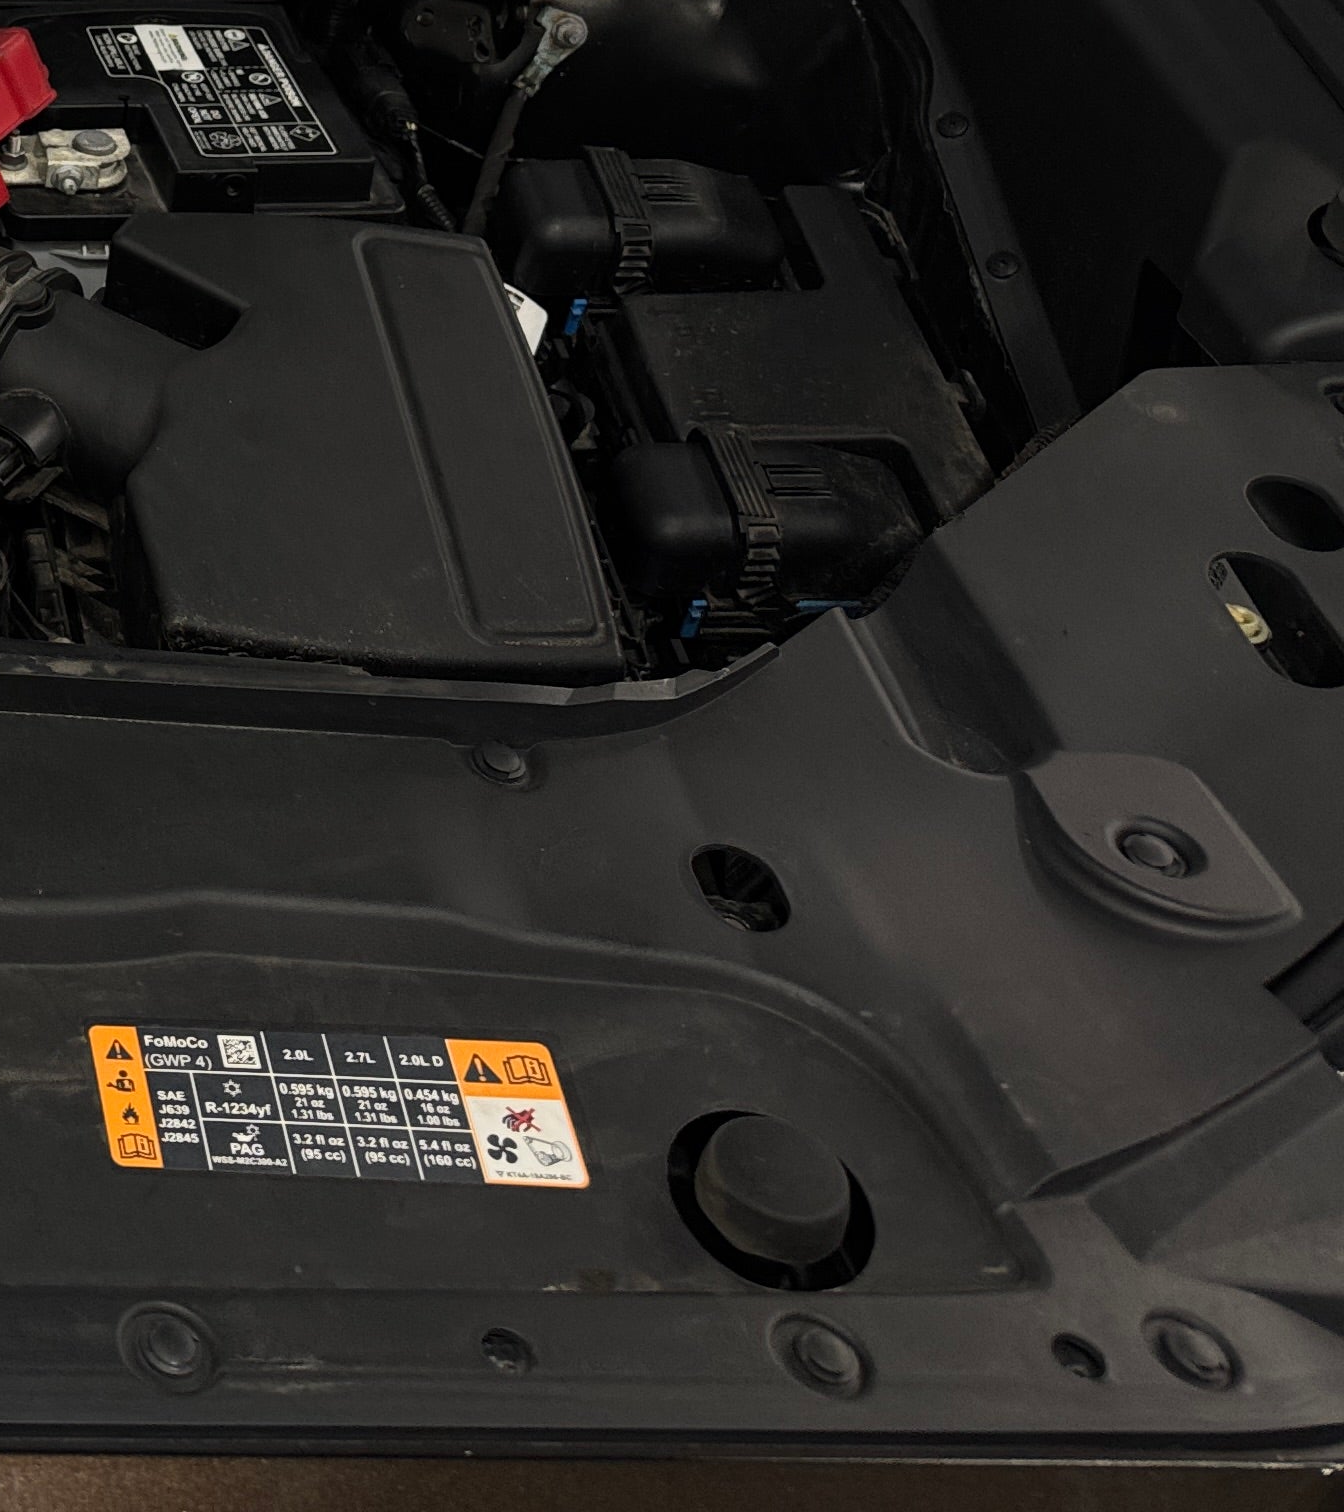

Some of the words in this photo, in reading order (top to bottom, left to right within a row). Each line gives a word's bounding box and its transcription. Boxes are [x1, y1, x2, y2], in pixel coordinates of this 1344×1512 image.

[143, 1034, 209, 1049] FoMoCo
[282, 1049, 314, 1061] 2.0L
[344, 1051, 376, 1064] 2.7L
[398, 1054, 430, 1067] 2.0L
[432, 1055, 444, 1067] D
[144, 1053, 192, 1068] (GWP
[195, 1055, 213, 1071] 4)
[157, 1090, 187, 1102] SAE
[278, 1082, 315, 1096] 0.595
[316, 1083, 335, 1100] kg
[341, 1085, 377, 1099] 0.595
[379, 1086, 398, 1102] kg
[404, 1088, 440, 1101] 0.454
[441, 1089, 460, 1105] kg
[294, 1096, 309, 1108] 21
[310, 1099, 326, 1109] oz
[357, 1099, 372, 1111] 21
[373, 1102, 389, 1111] oz
[420, 1102, 435, 1114] 16
[436, 1105, 451, 1115] oz
[158, 1104, 191, 1115] J639
[204, 1101, 272, 1119] R-1234yf
[291, 1108, 314, 1120] 1.31
[315, 1109, 335, 1121] lbs
[158, 1117, 198, 1129] J2842
[354, 1111, 377, 1124] 1.31
[379, 1112, 398, 1124] lbs
[417, 1114, 441, 1126] 1.00
[441, 1116, 461, 1127] lbs
[161, 1131, 200, 1144] J2845
[292, 1133, 312, 1146] 3.2
[315, 1134, 326, 1145] fl
[328, 1137, 346, 1147] oz
[356, 1136, 377, 1148] 3.2
[379, 1137, 390, 1149] fl
[392, 1139, 410, 1150] oz
[230, 1142, 266, 1156] PAG
[418, 1139, 440, 1151] 5.4
[441, 1140, 452, 1152] fl
[454, 1143, 472, 1153] oz
[300, 1148, 323, 1162] (95
[324, 1149, 347, 1164] cc)
[364, 1151, 387, 1165] (95
[388, 1153, 411, 1167] cc)
[423, 1153, 453, 1168] (160
[455, 1156, 477, 1170] cc)
